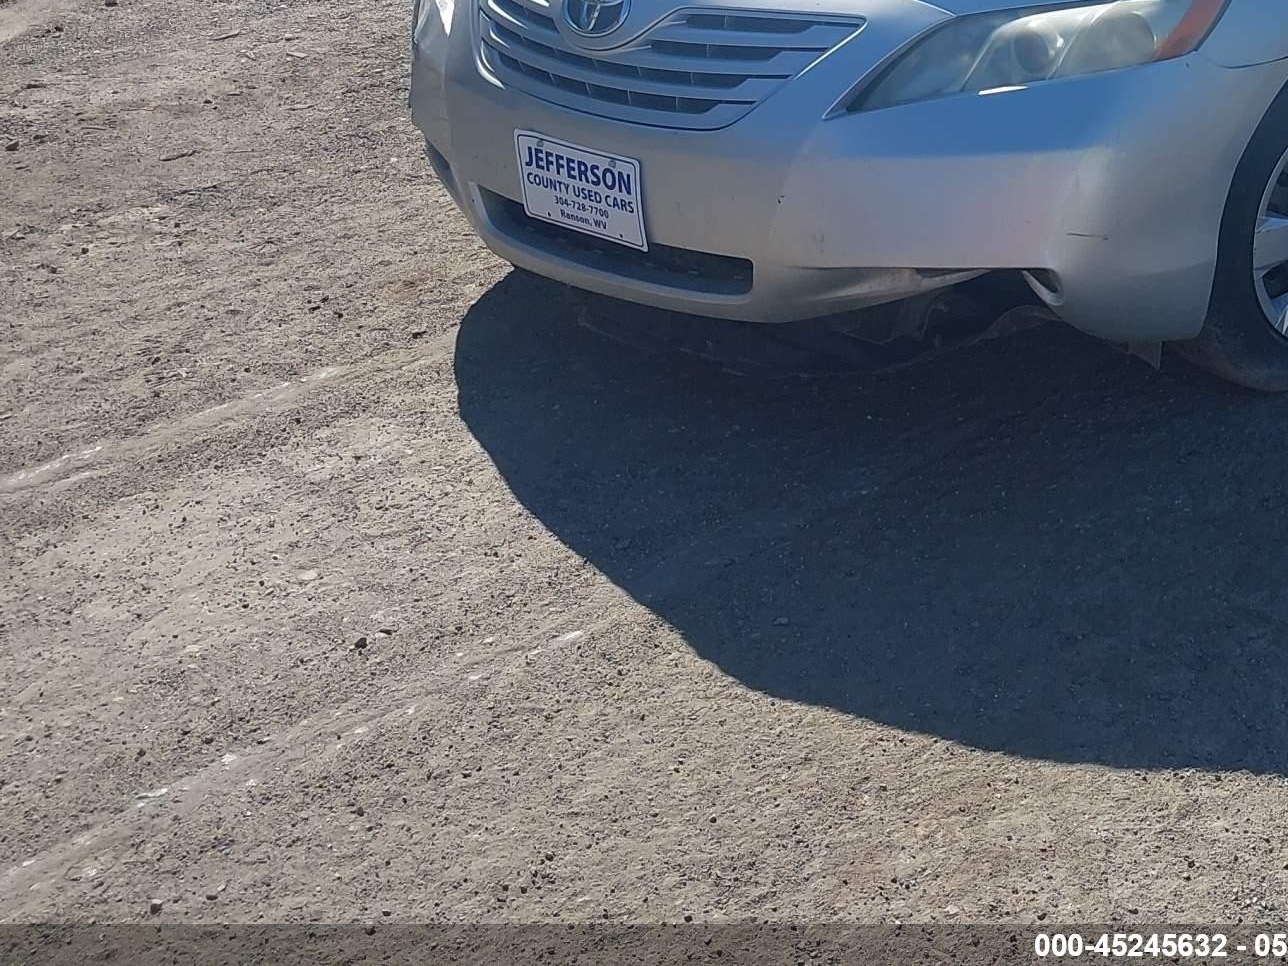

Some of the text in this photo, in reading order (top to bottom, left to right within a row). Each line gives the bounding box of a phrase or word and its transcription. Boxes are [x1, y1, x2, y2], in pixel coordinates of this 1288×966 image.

[525, 146, 632, 195] JEFFERSON
[527, 172, 635, 214] COUNTY USED CARS
[554, 195, 609, 219] 304-728-7700
[593, 218, 607, 230] WV
